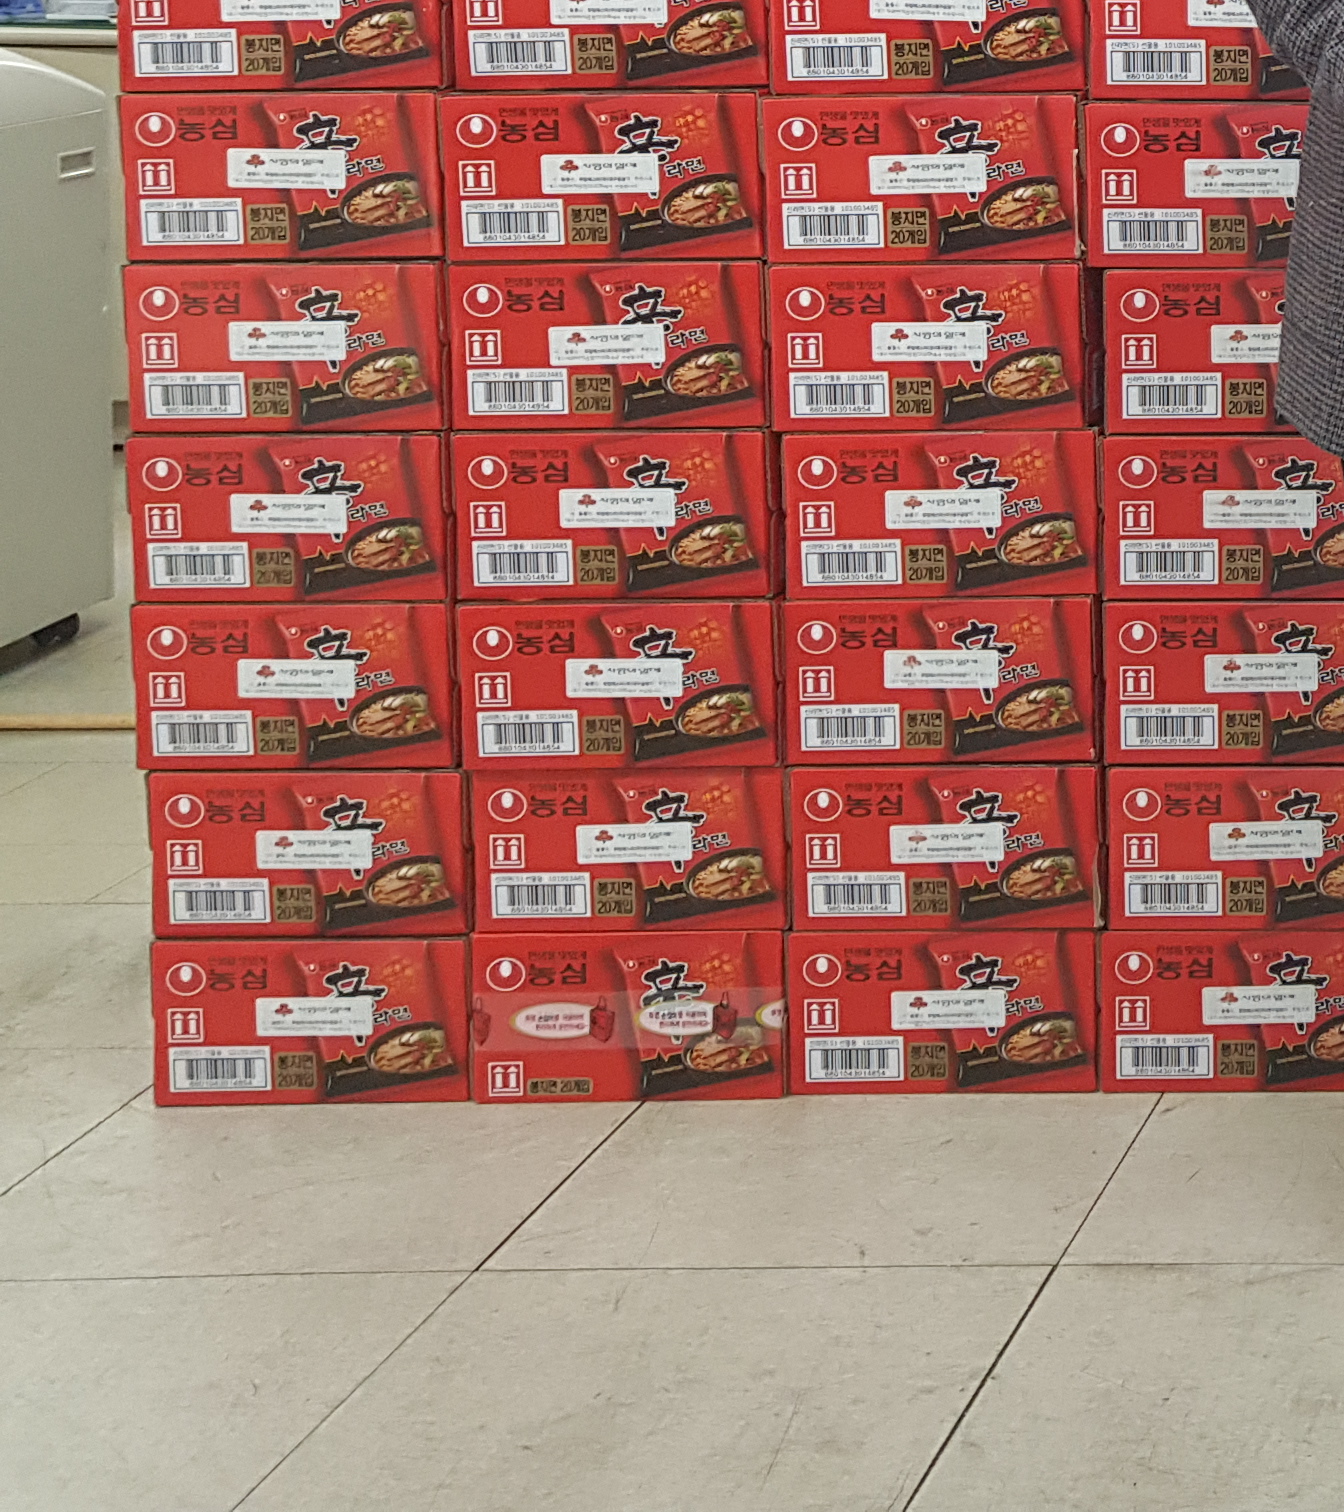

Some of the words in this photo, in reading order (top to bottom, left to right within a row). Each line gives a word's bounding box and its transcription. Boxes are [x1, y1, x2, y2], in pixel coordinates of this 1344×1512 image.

[577, 38, 613, 53] 봉지면
[894, 43, 930, 58] 봉지면
[577, 56, 614, 72] 20개입
[894, 61, 931, 77] 20개입
[178, 119, 239, 142] 농심
[499, 121, 560, 143] 농심
[821, 124, 881, 146] 농심
[1141, 130, 1199, 153] 농심
[664, 159, 706, 178] 라면
[985, 162, 1026, 181] 라면
[570, 209, 607, 224] 봉지면
[890, 212, 927, 227] 봉지면
[571, 228, 607, 243] 20개입
[891, 230, 927, 246] 20개입
[505, 290, 565, 313] 농심
[828, 293, 887, 316] 농심
[1162, 295, 1221, 317] 농심
[989, 332, 1030, 351] 라면
[896, 381, 931, 396] 봉지면
[896, 400, 932, 415] 20개입
[510, 461, 570, 483] 농심
[840, 461, 900, 484] 농심
[1160, 461, 1218, 484] 농심
[1002, 498, 1044, 517] 라면
[908, 549, 944, 563] 봉지면
[909, 567, 944, 582] 20개입
[516, 632, 576, 654] 농심
[839, 625, 899, 647] 농심
[1160, 627, 1219, 649] 농심
[530, 795, 589, 817] 농심
[845, 795, 904, 817] 농심
